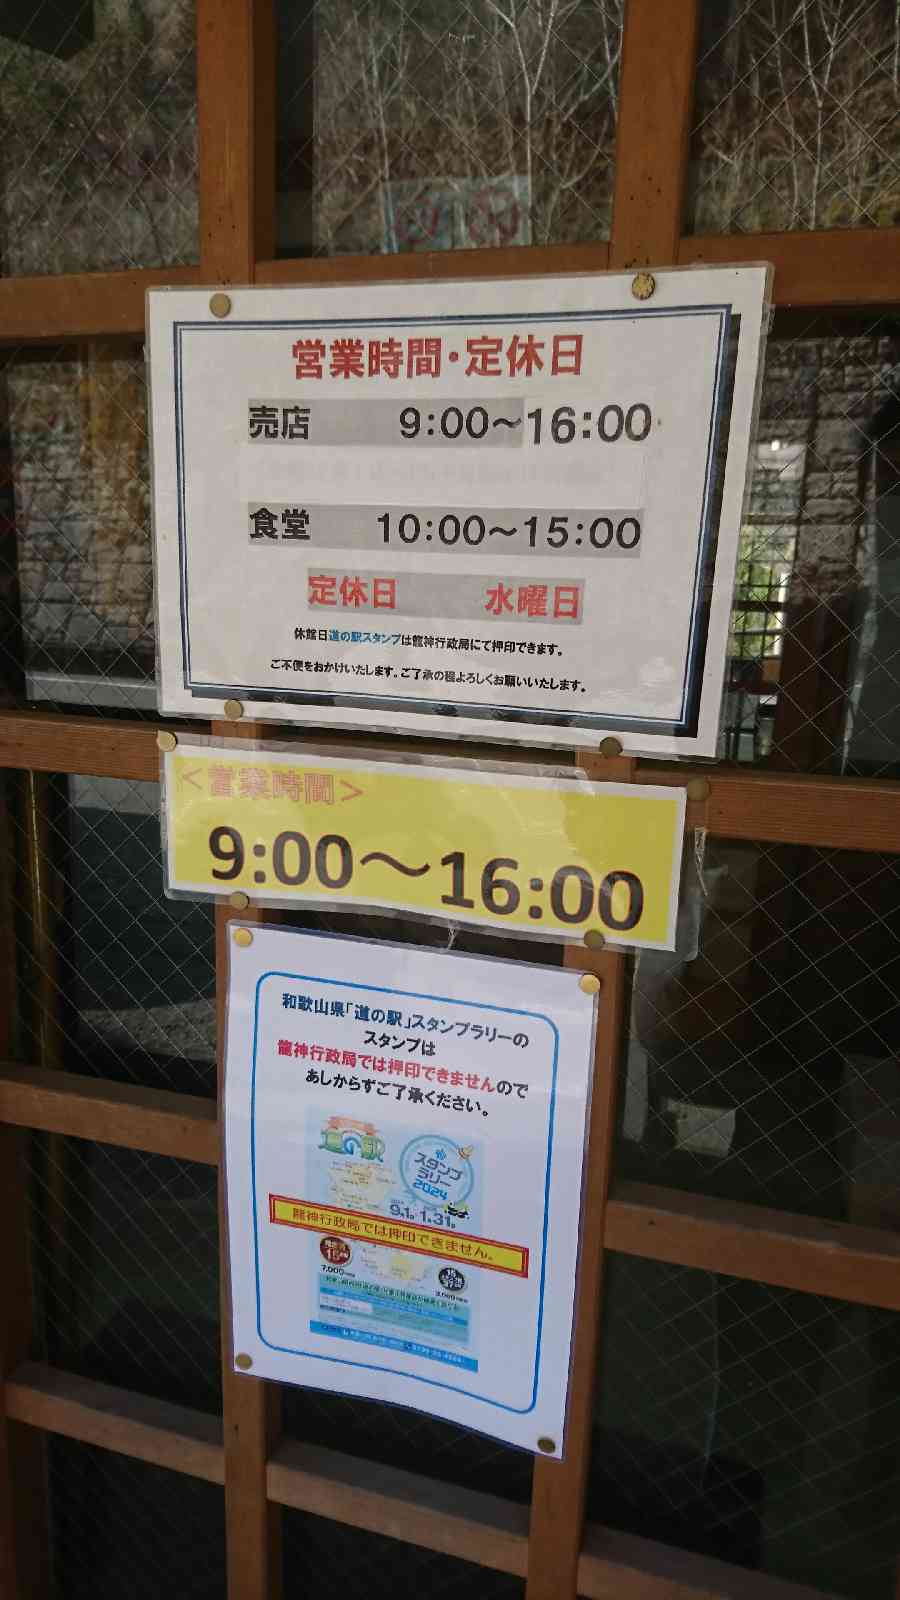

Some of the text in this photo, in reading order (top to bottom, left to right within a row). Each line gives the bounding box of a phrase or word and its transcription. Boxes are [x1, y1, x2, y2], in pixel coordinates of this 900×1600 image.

[292, 334, 584, 379] 営業時間・定休日
[248, 406, 310, 441] 売店
[249, 508, 310, 541] 食堂
[308, 575, 582, 618] 定休日 水曜日
[364, 1030, 436, 1056] スタンプは
[277, 1039, 529, 1099] 龍神行政局では押印できませんので
[305, 1068, 488, 1116] あしからずご了承ください。
[414, 1152, 464, 1181] スタンプ
[417, 1167, 452, 1187] ラリー
[412, 1178, 448, 1200] 2024
